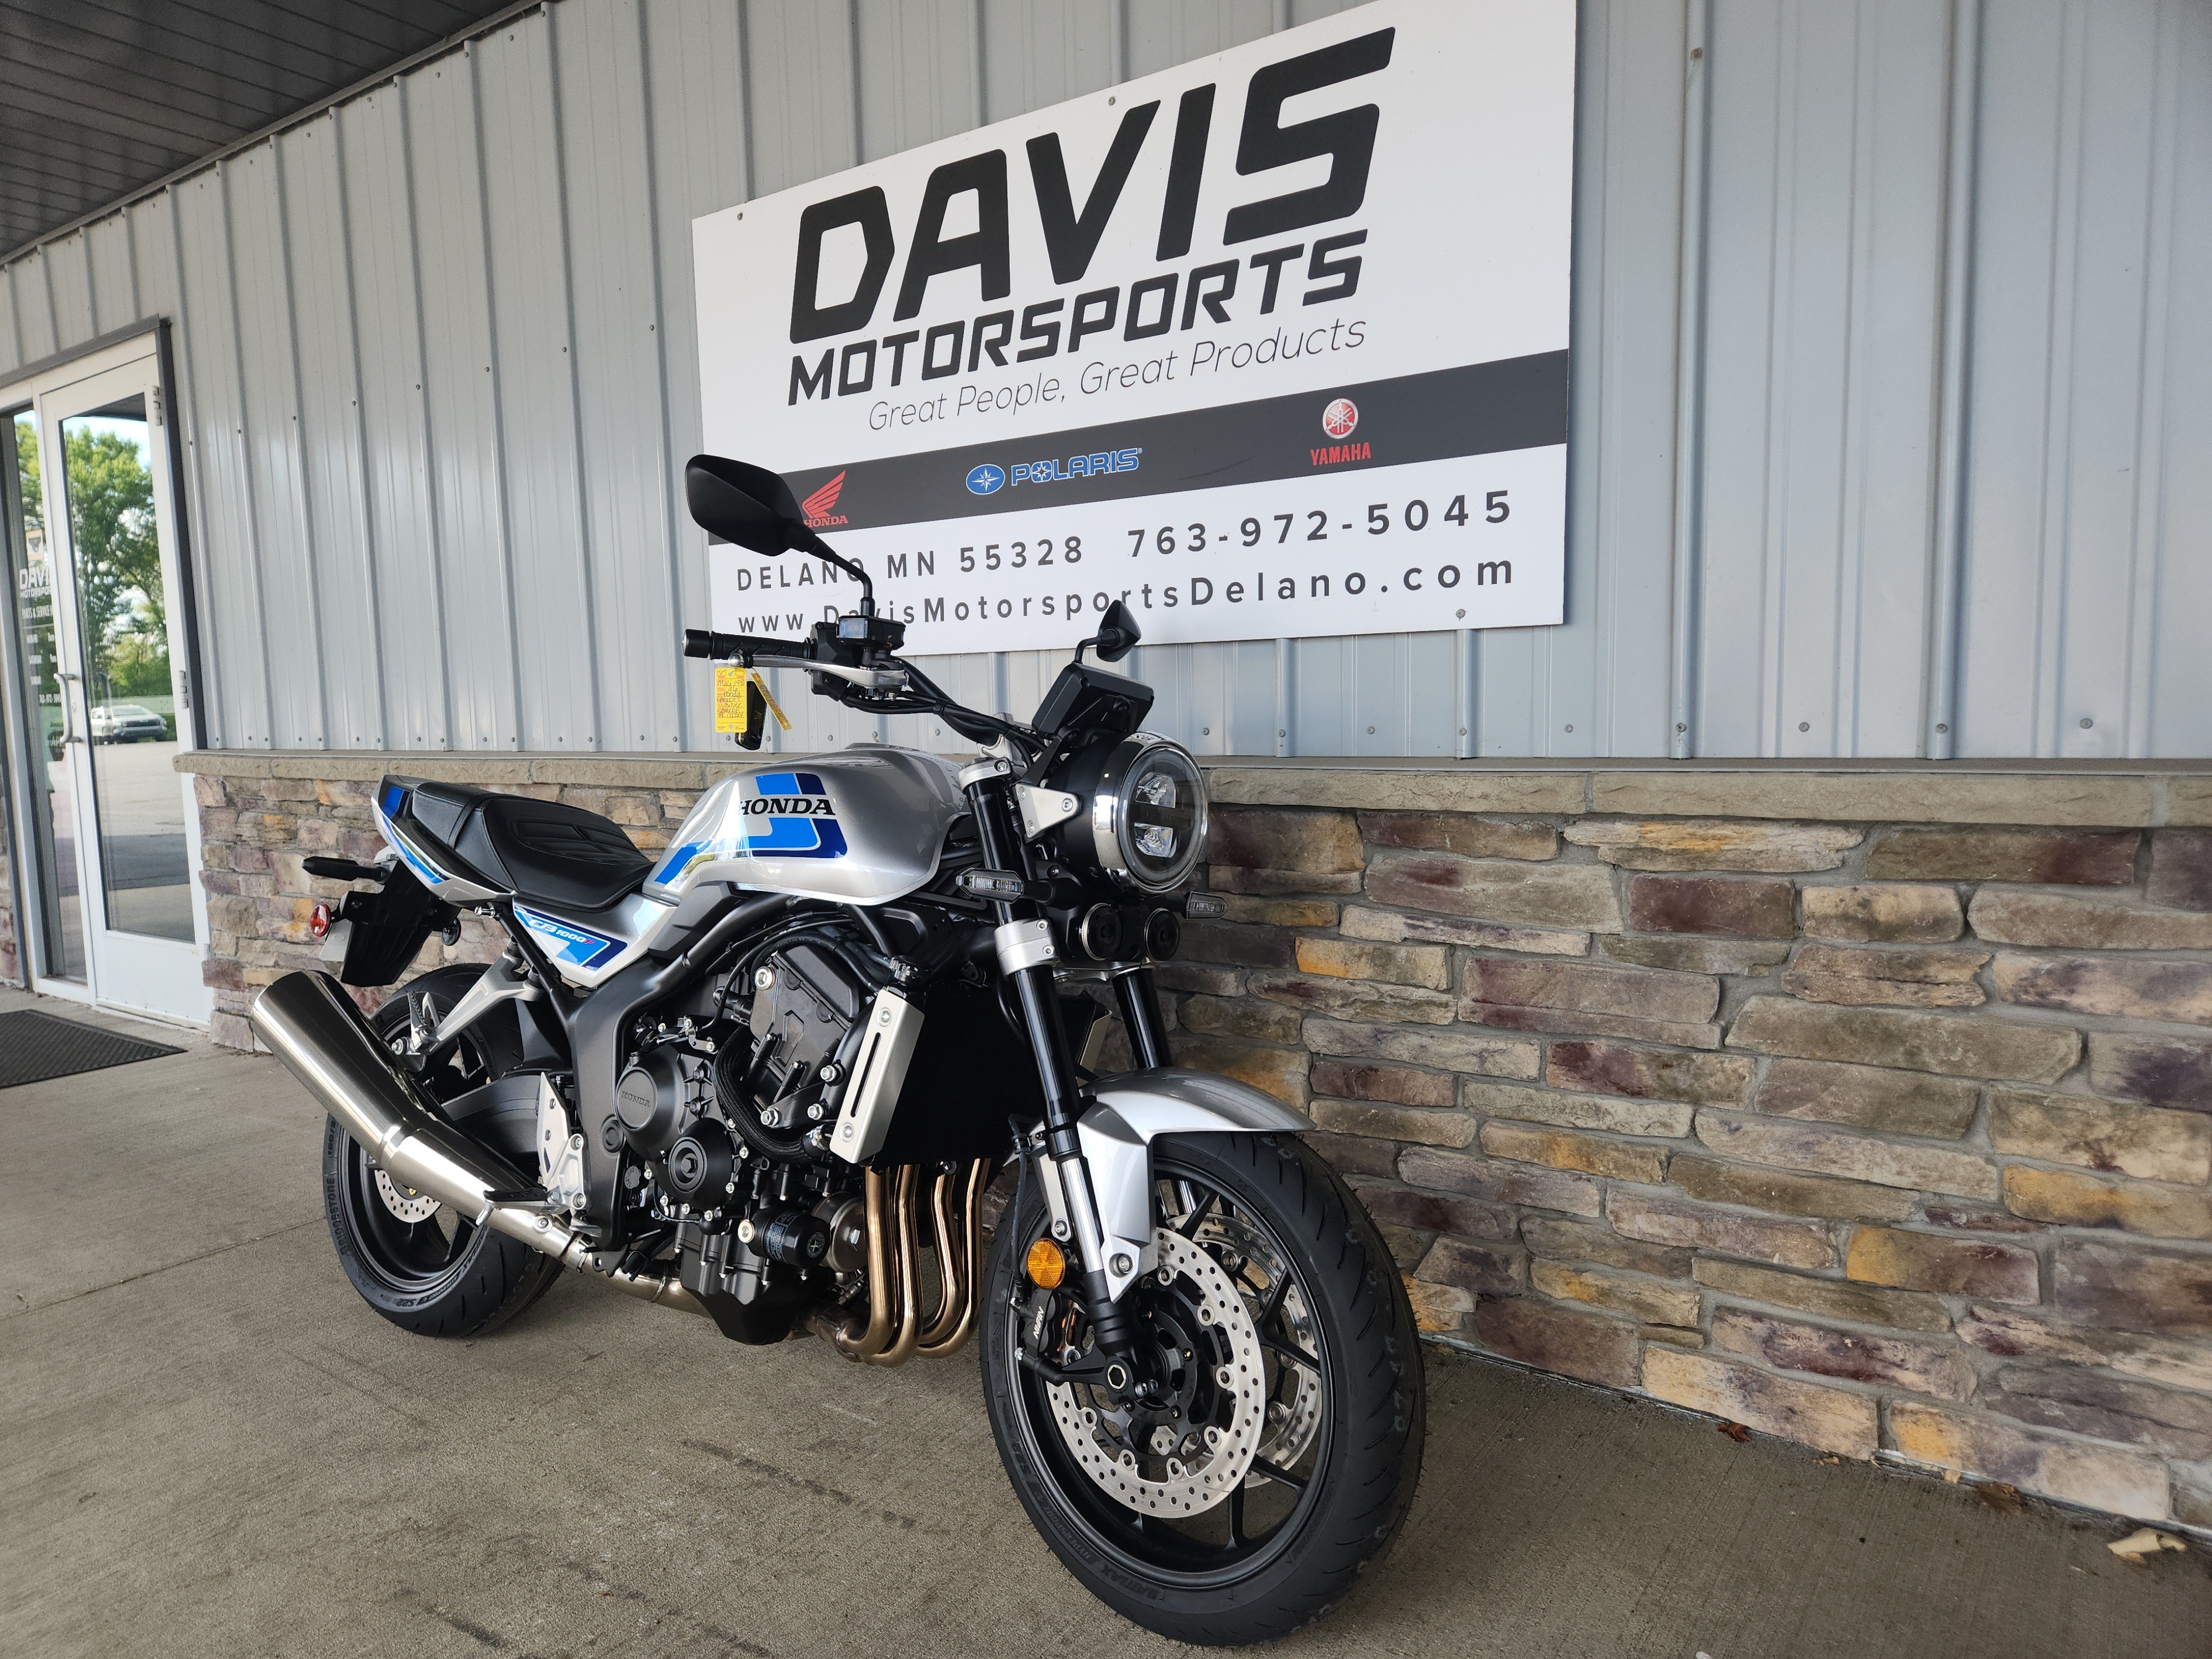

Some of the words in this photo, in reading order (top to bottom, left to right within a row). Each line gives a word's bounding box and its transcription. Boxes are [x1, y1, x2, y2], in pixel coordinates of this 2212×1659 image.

[790, 27, 1396, 344] DAVIS
[789, 229, 1368, 406] MOTORSPORTS
[869, 393, 946, 430] Great
[957, 373, 1065, 416] People,
[1081, 351, 1178, 394] Great
[1190, 319, 1366, 376] Products
[1011, 448, 1140, 486] POLARIS
[1310, 442, 1371, 466] YAMAHA
[804, 515, 849, 528] HONDA
[738, 557, 864, 591] DELANO
[887, 551, 935, 579] MN
[960, 536, 1082, 572] 55328
[1128, 490, 1510, 557] 763-972-5045
[19, 566, 50, 590] DAVI
[738, 560, 1511, 633] wwwDisMotorsportsDelano.com
[740, 798, 836, 816] HONDA
[528, 919, 597, 946] CB1000F
[621, 1090, 651, 1108] HONDA
